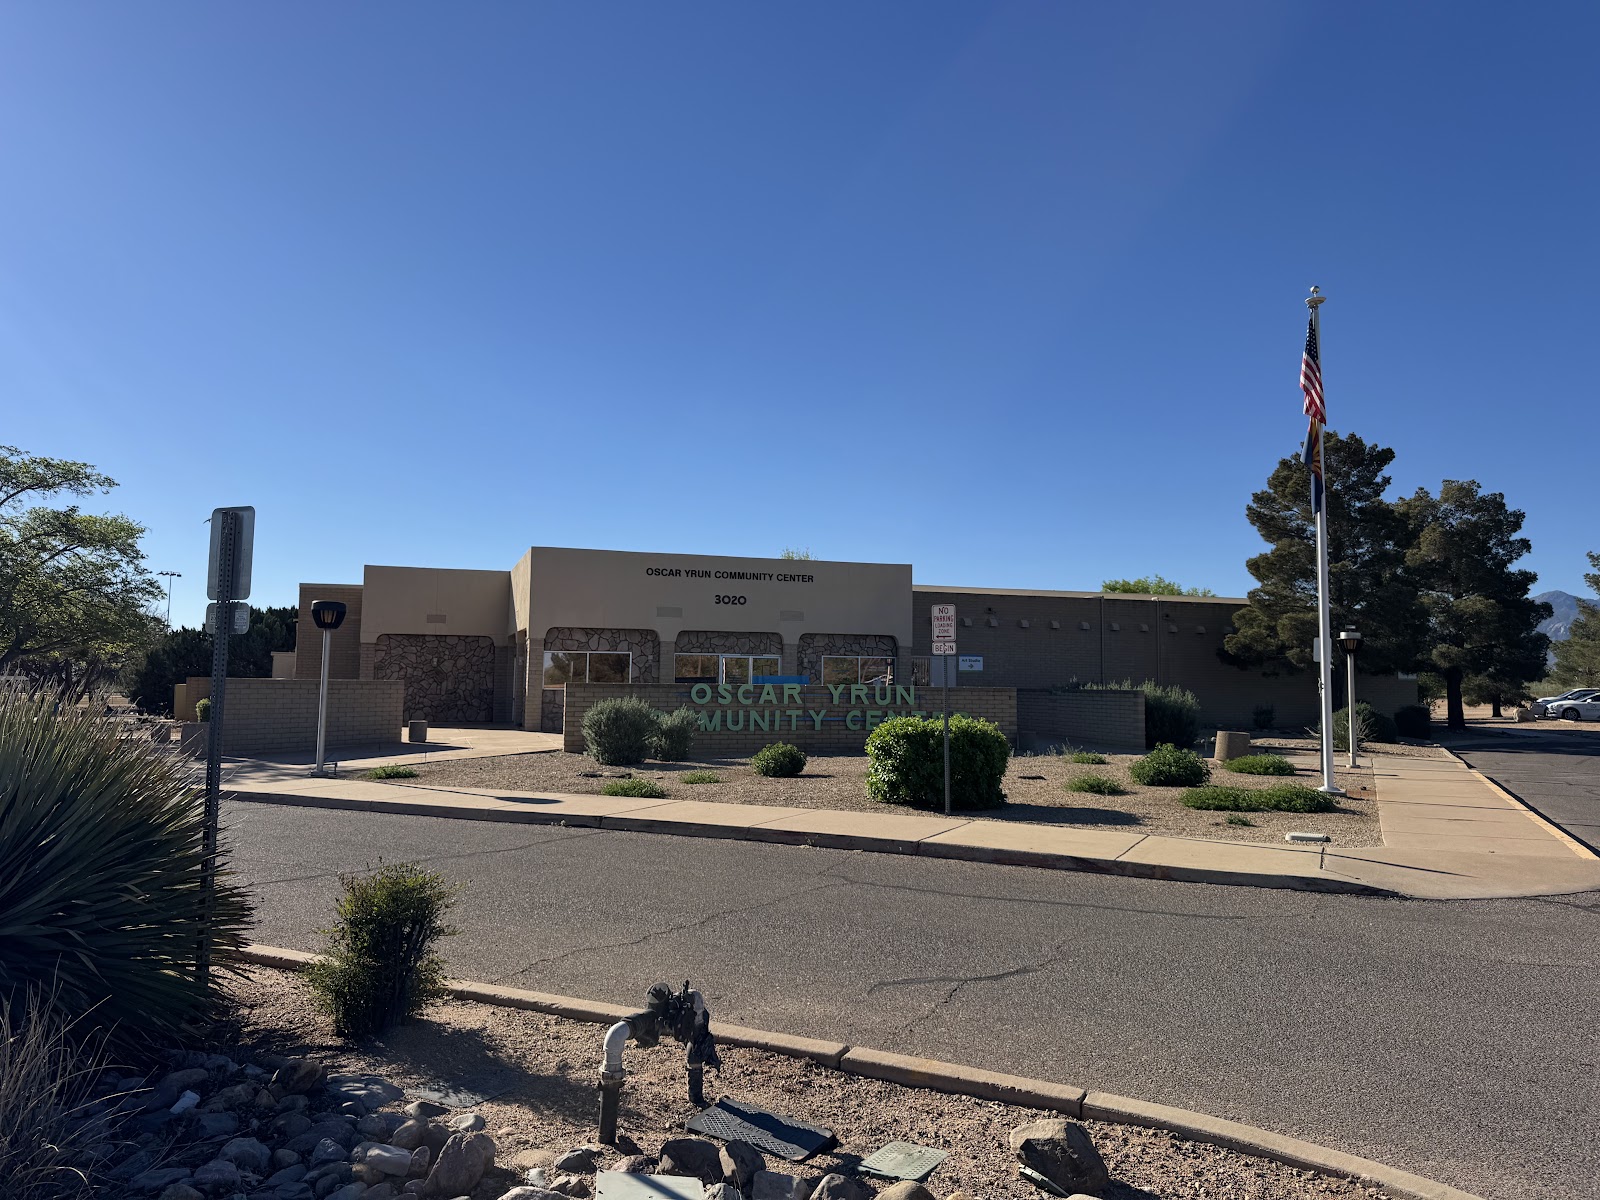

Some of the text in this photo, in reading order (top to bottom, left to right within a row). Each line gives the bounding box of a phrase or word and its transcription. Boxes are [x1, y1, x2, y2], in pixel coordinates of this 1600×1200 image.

[646, 568, 814, 583] OSCAR YRUN COMMUNITY CENTER
[714, 595, 747, 605] 3020
[690, 683, 916, 706] OSCAR YRUN
[653, 709, 827, 732] MUNITY
